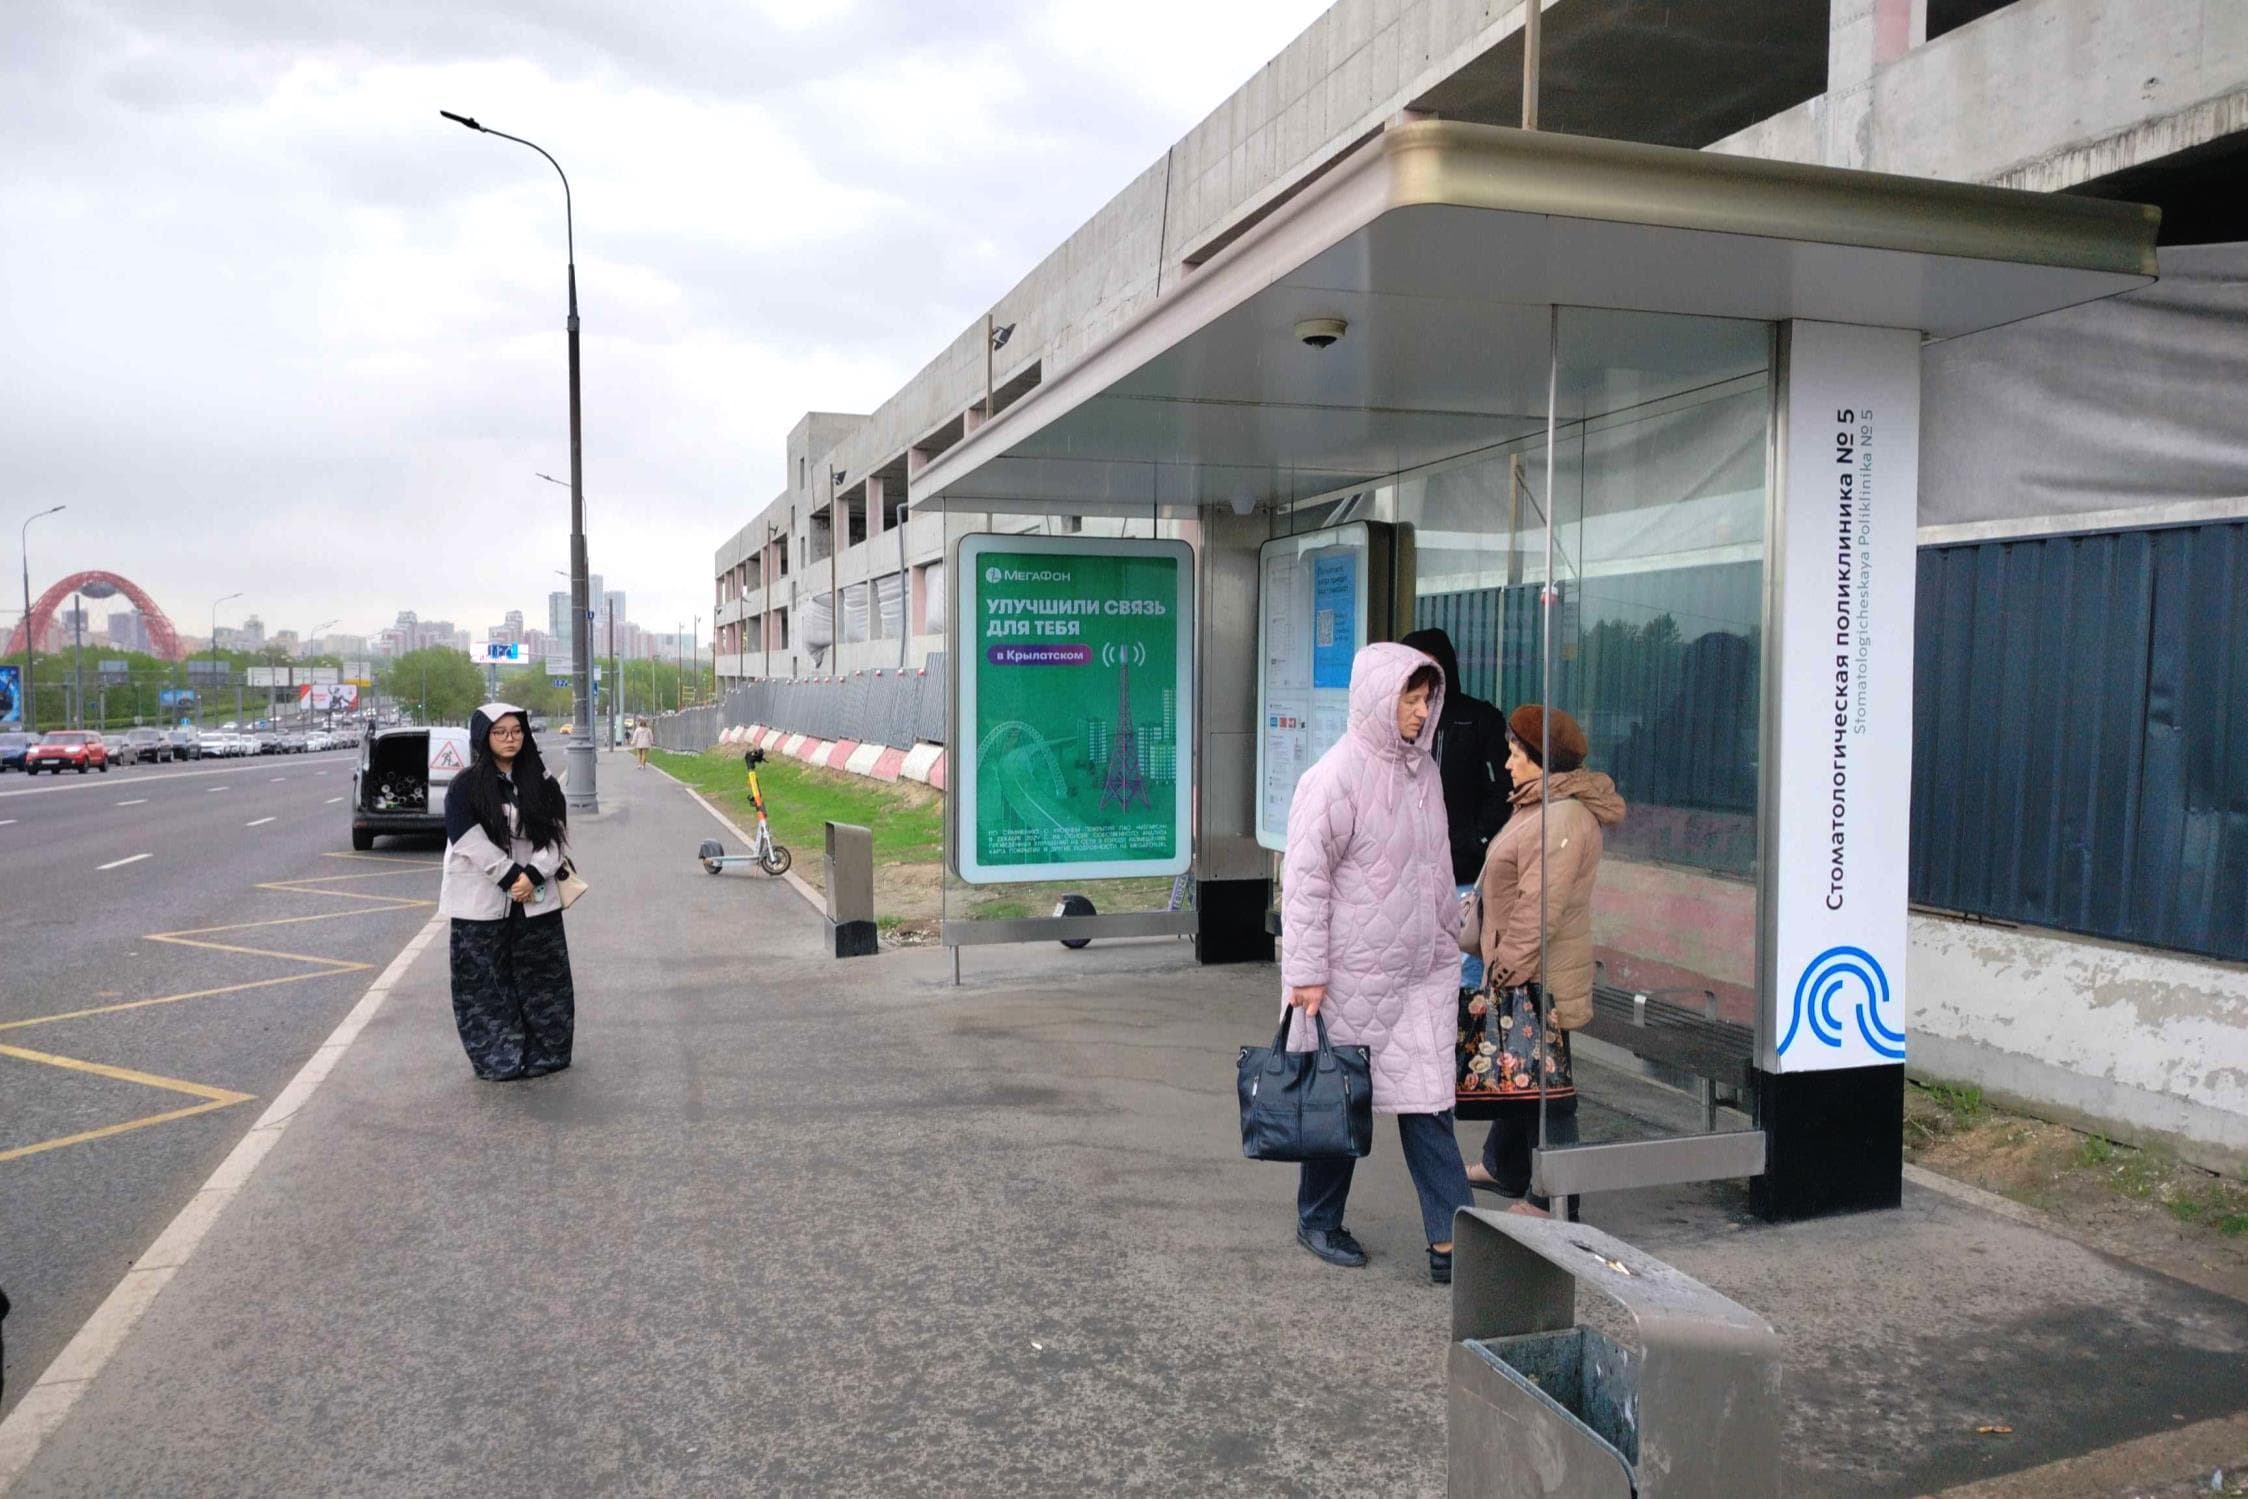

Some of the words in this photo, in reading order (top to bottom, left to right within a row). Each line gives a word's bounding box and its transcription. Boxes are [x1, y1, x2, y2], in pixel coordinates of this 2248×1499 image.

[1837, 408, 1855, 425] 5
[1861, 409, 1874, 422] 5
[1860, 424, 1874, 447] №
[1835, 431, 1855, 465] №
[1857, 453, 1873, 546] Poliklinika
[1836, 473, 1854, 647] поликлиника
[986, 599, 1100, 615] УЛУЧШИЛИ
[1104, 600, 1166, 616] СВЯЗЬ
[986, 620, 1030, 637] ДЛЯ
[1034, 620, 1080, 636] ТЕБЯ
[1853, 552, 1873, 735] Stomatologicheskaya
[996, 652, 1004, 660] в
[1006, 650, 1084, 662] Крылатском
[1825, 654, 1850, 912] Стоматологическая
